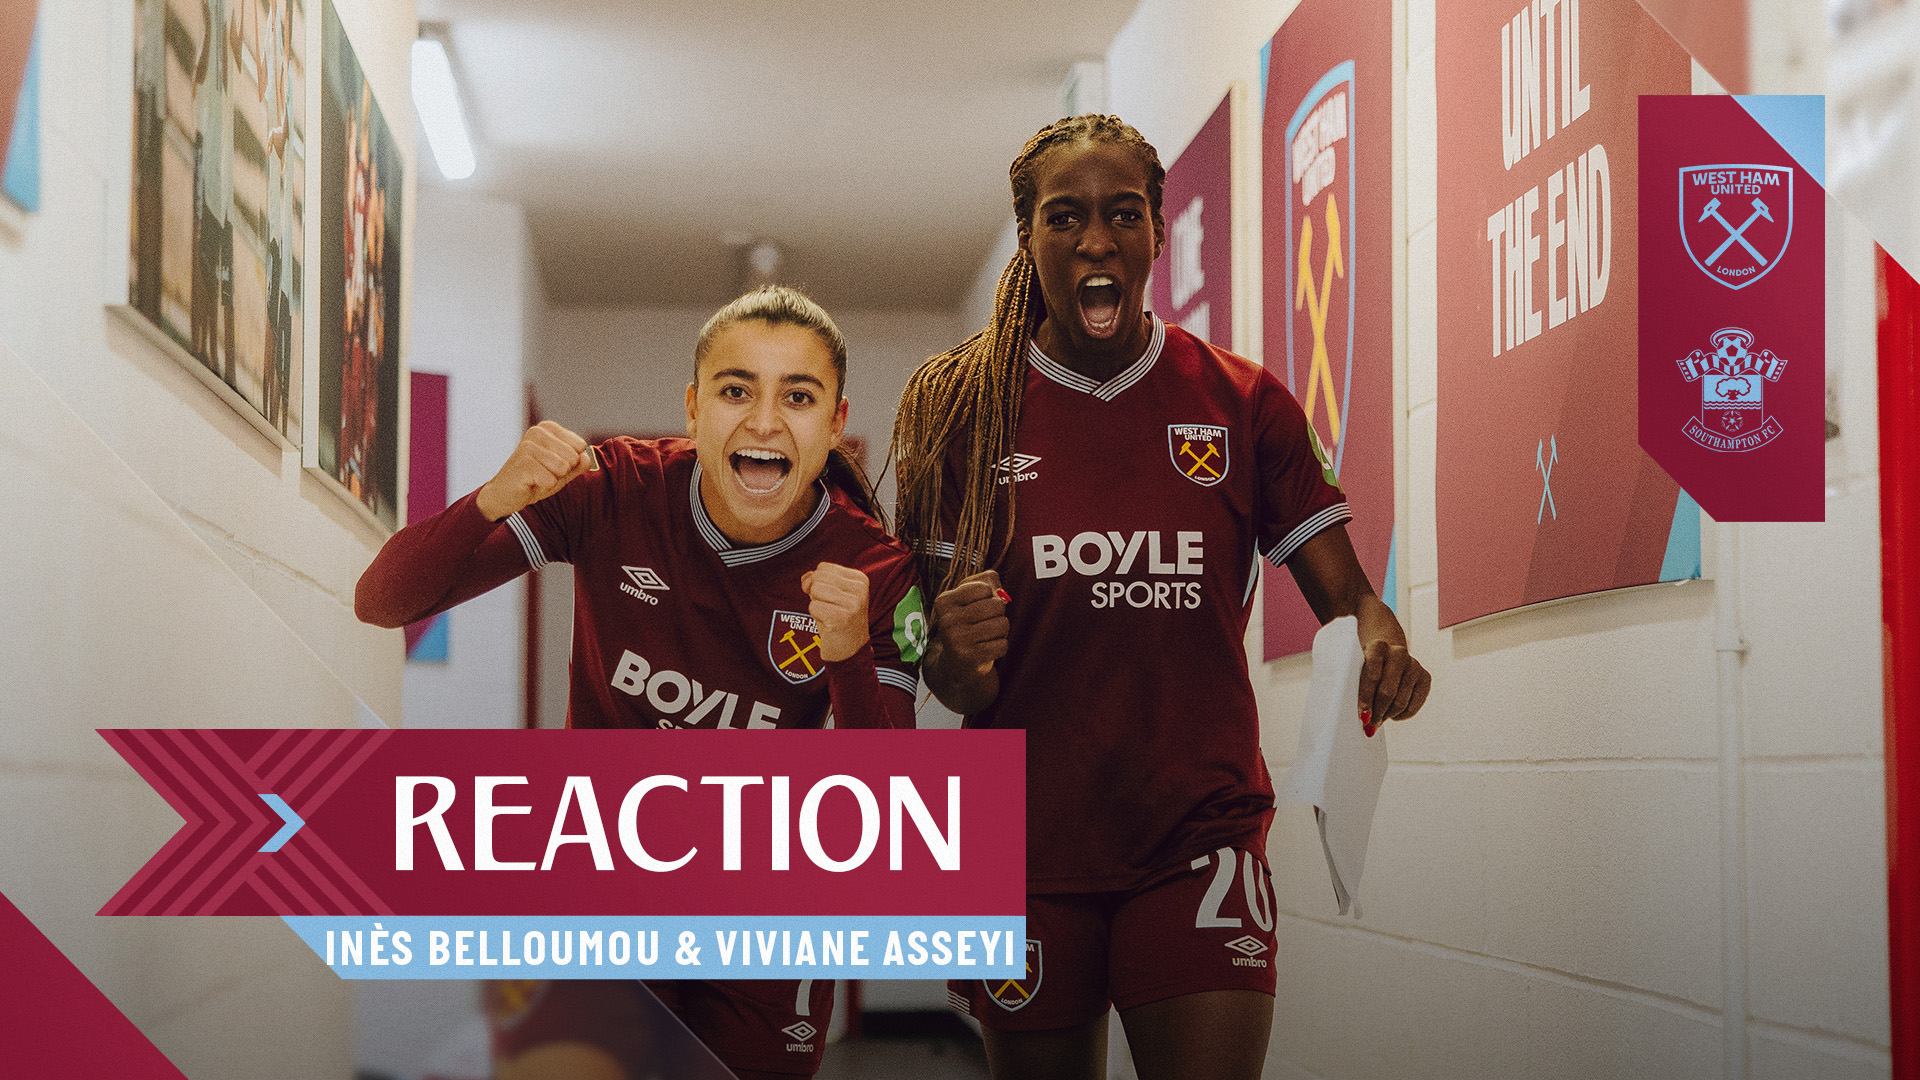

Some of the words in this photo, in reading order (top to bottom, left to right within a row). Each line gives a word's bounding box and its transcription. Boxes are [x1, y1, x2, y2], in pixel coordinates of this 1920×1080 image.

[1501, 0, 1591, 171] UNTIL
[1487, 185, 1542, 358] THE
[1548, 144, 1612, 330] END
[1174, 427, 1198, 436] WEST
[1200, 428, 1222, 438] HAM
[1184, 434, 1213, 442] UNITED
[1031, 530, 1204, 579] BOYLE
[619, 582, 659, 606] umbro
[1090, 581, 1202, 610] SPORTS
[780, 613, 808, 625] WEST
[785, 669, 809, 679] LONDON
[611, 649, 782, 729] BOYLE
[1191, 846, 1274, 932] 20
[1231, 956, 1268, 968] umbro
[786, 1042, 814, 1053] umbro
